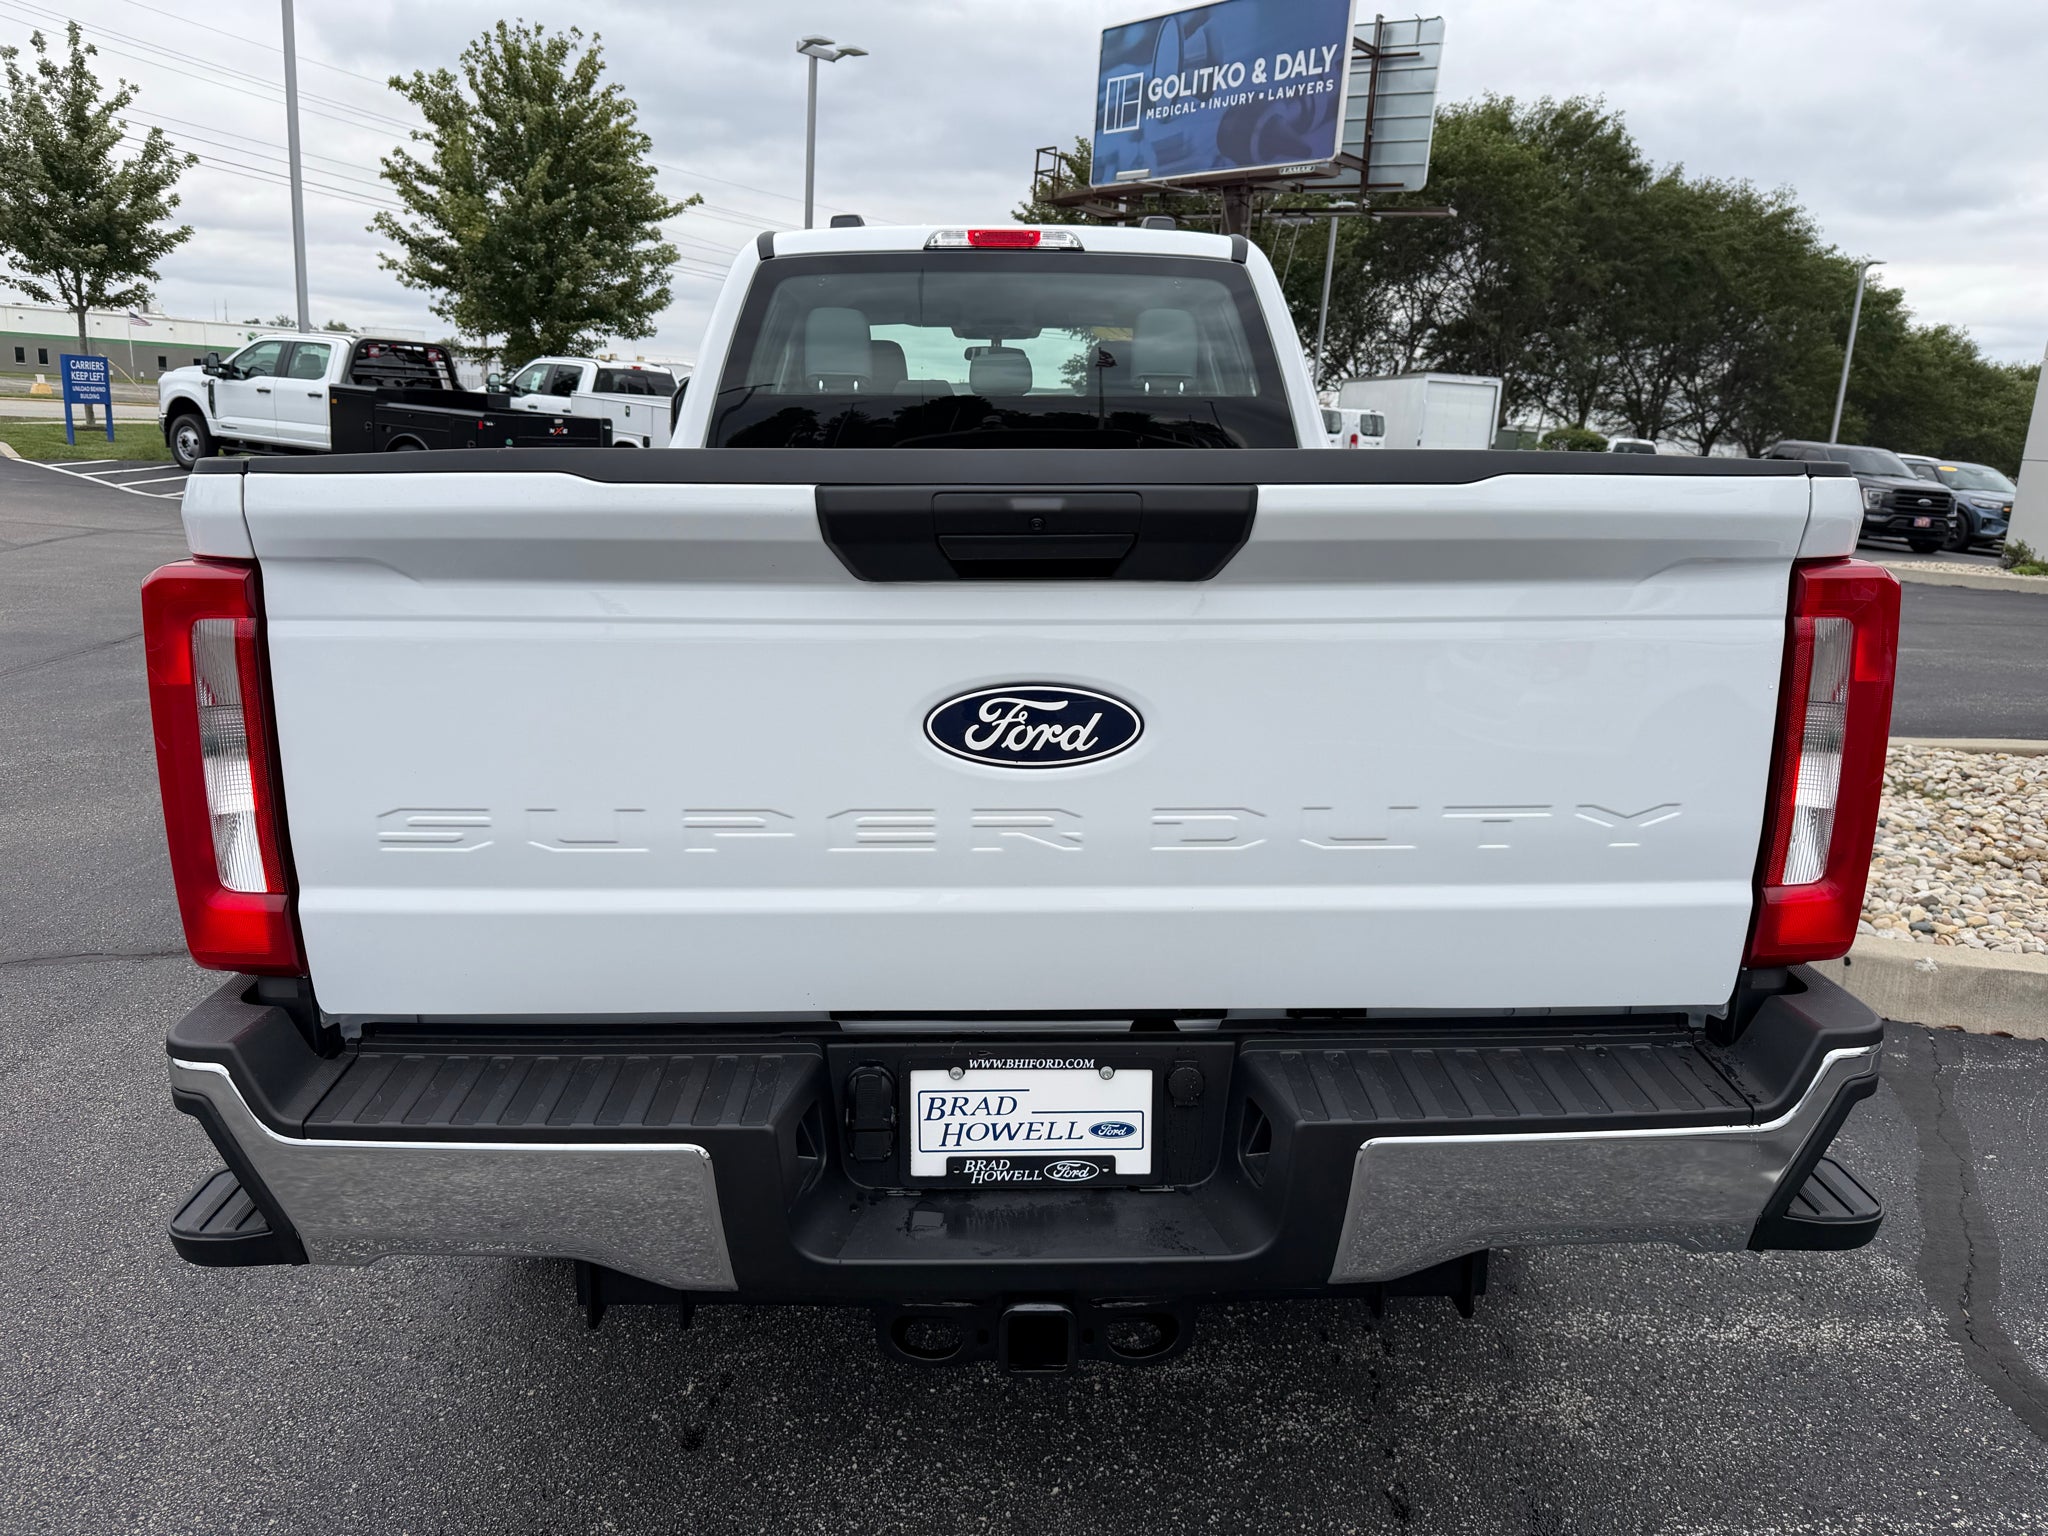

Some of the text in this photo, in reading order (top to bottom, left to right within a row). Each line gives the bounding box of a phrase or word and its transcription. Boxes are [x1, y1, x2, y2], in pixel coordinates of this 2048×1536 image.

[1147, 44, 1339, 102] GOLITKO & DALY
[1145, 79, 1335, 120] MEDICAL INJURY LAWYERS
[70, 360, 105, 370] CARRIERS
[71, 371, 105, 381] KEEP LEFT
[963, 697, 1103, 752] Ford
[377, 803, 1683, 852] SUPER DUTY
[968, 1058, 1095, 1070] WWW.BHIFORD.COM
[923, 1096, 1018, 1121] BRAD
[938, 1121, 1128, 1147] HOWELL Ford
[963, 1159, 1011, 1173] BRAD
[970, 1161, 1090, 1184] HOWELL Ford
